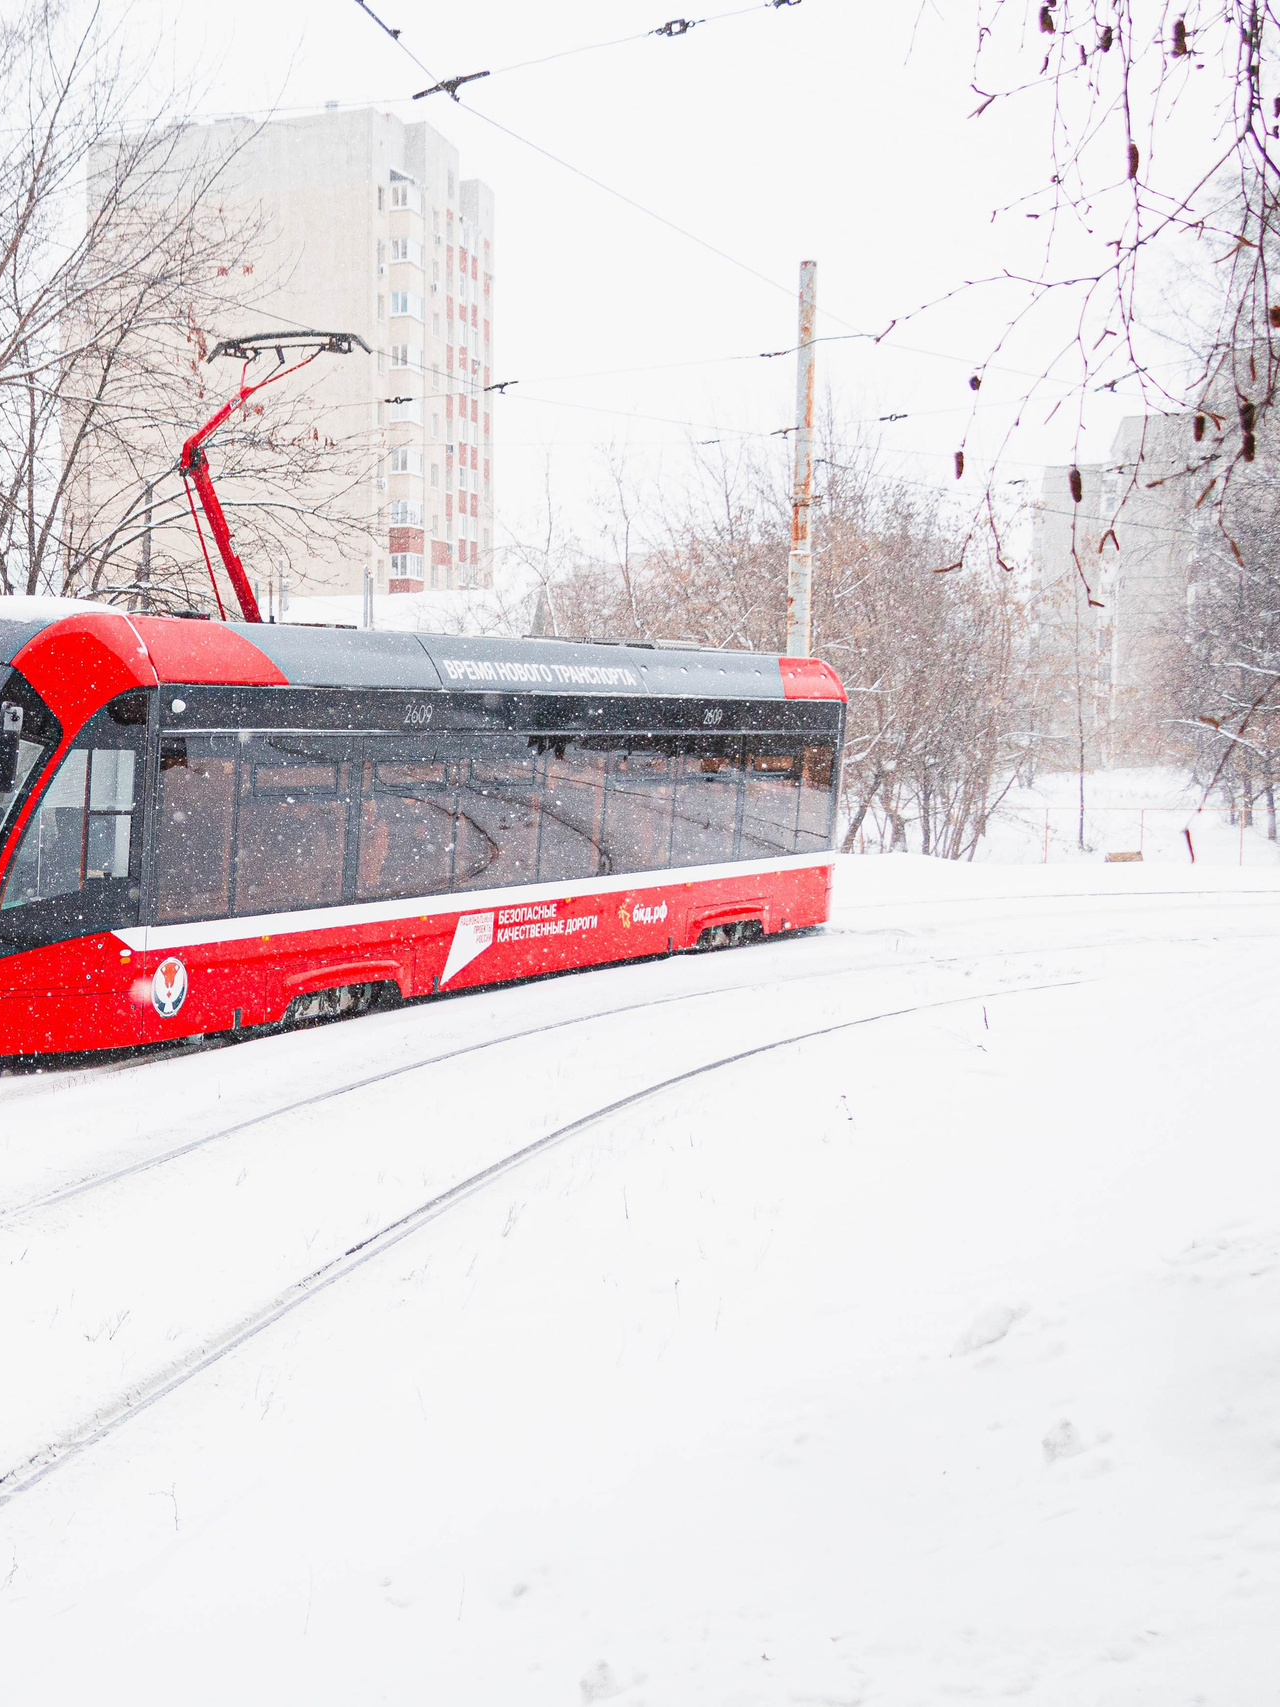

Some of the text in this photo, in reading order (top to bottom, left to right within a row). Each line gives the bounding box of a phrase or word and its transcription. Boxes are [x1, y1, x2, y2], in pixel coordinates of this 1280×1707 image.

[442, 659, 637, 687] ВРЕМЯ НОВОГО ТРАНСПОРТА
[403, 704, 433, 724] 2609
[498, 903, 558, 925] БЕЗОПАСНЫЕ
[632, 899, 668, 925] бкд.рф
[497, 915, 598, 943] КАЧЕСТВЕННЫЕ ДОРОГИ
